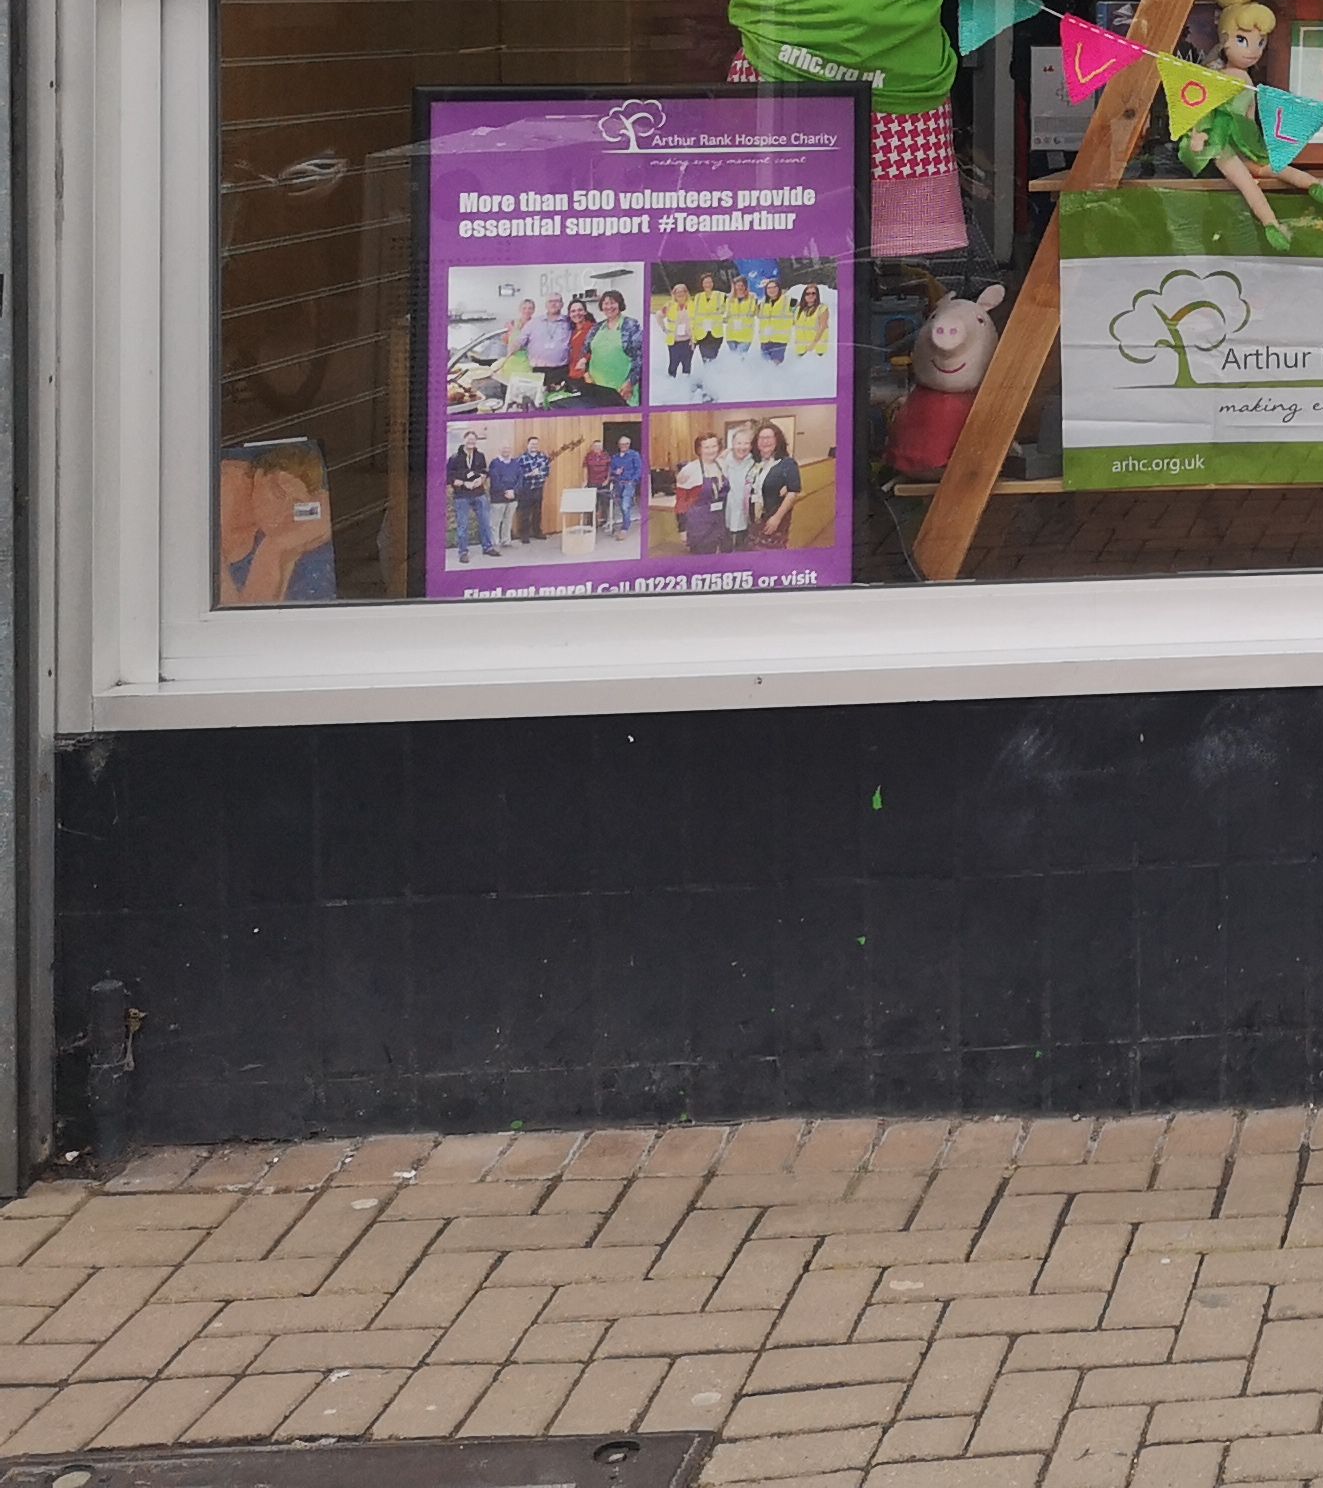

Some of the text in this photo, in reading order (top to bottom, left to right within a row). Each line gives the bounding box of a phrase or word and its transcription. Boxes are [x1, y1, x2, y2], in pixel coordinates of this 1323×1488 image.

[652, 130, 838, 149] Arthur Rank Hospice Charity
[459, 186, 816, 213] More than 500 volunteers provide
[458, 211, 796, 237] essential support #TeamArthur
[1221, 345, 1311, 372] Arthur
[1219, 399, 1302, 423] making
[1111, 453, 1205, 475] arhc.org.uk
[634, 574, 690, 593] 01223
[691, 571, 753, 591] 675875
[758, 576, 779, 588] or
[781, 568, 818, 586] visit
